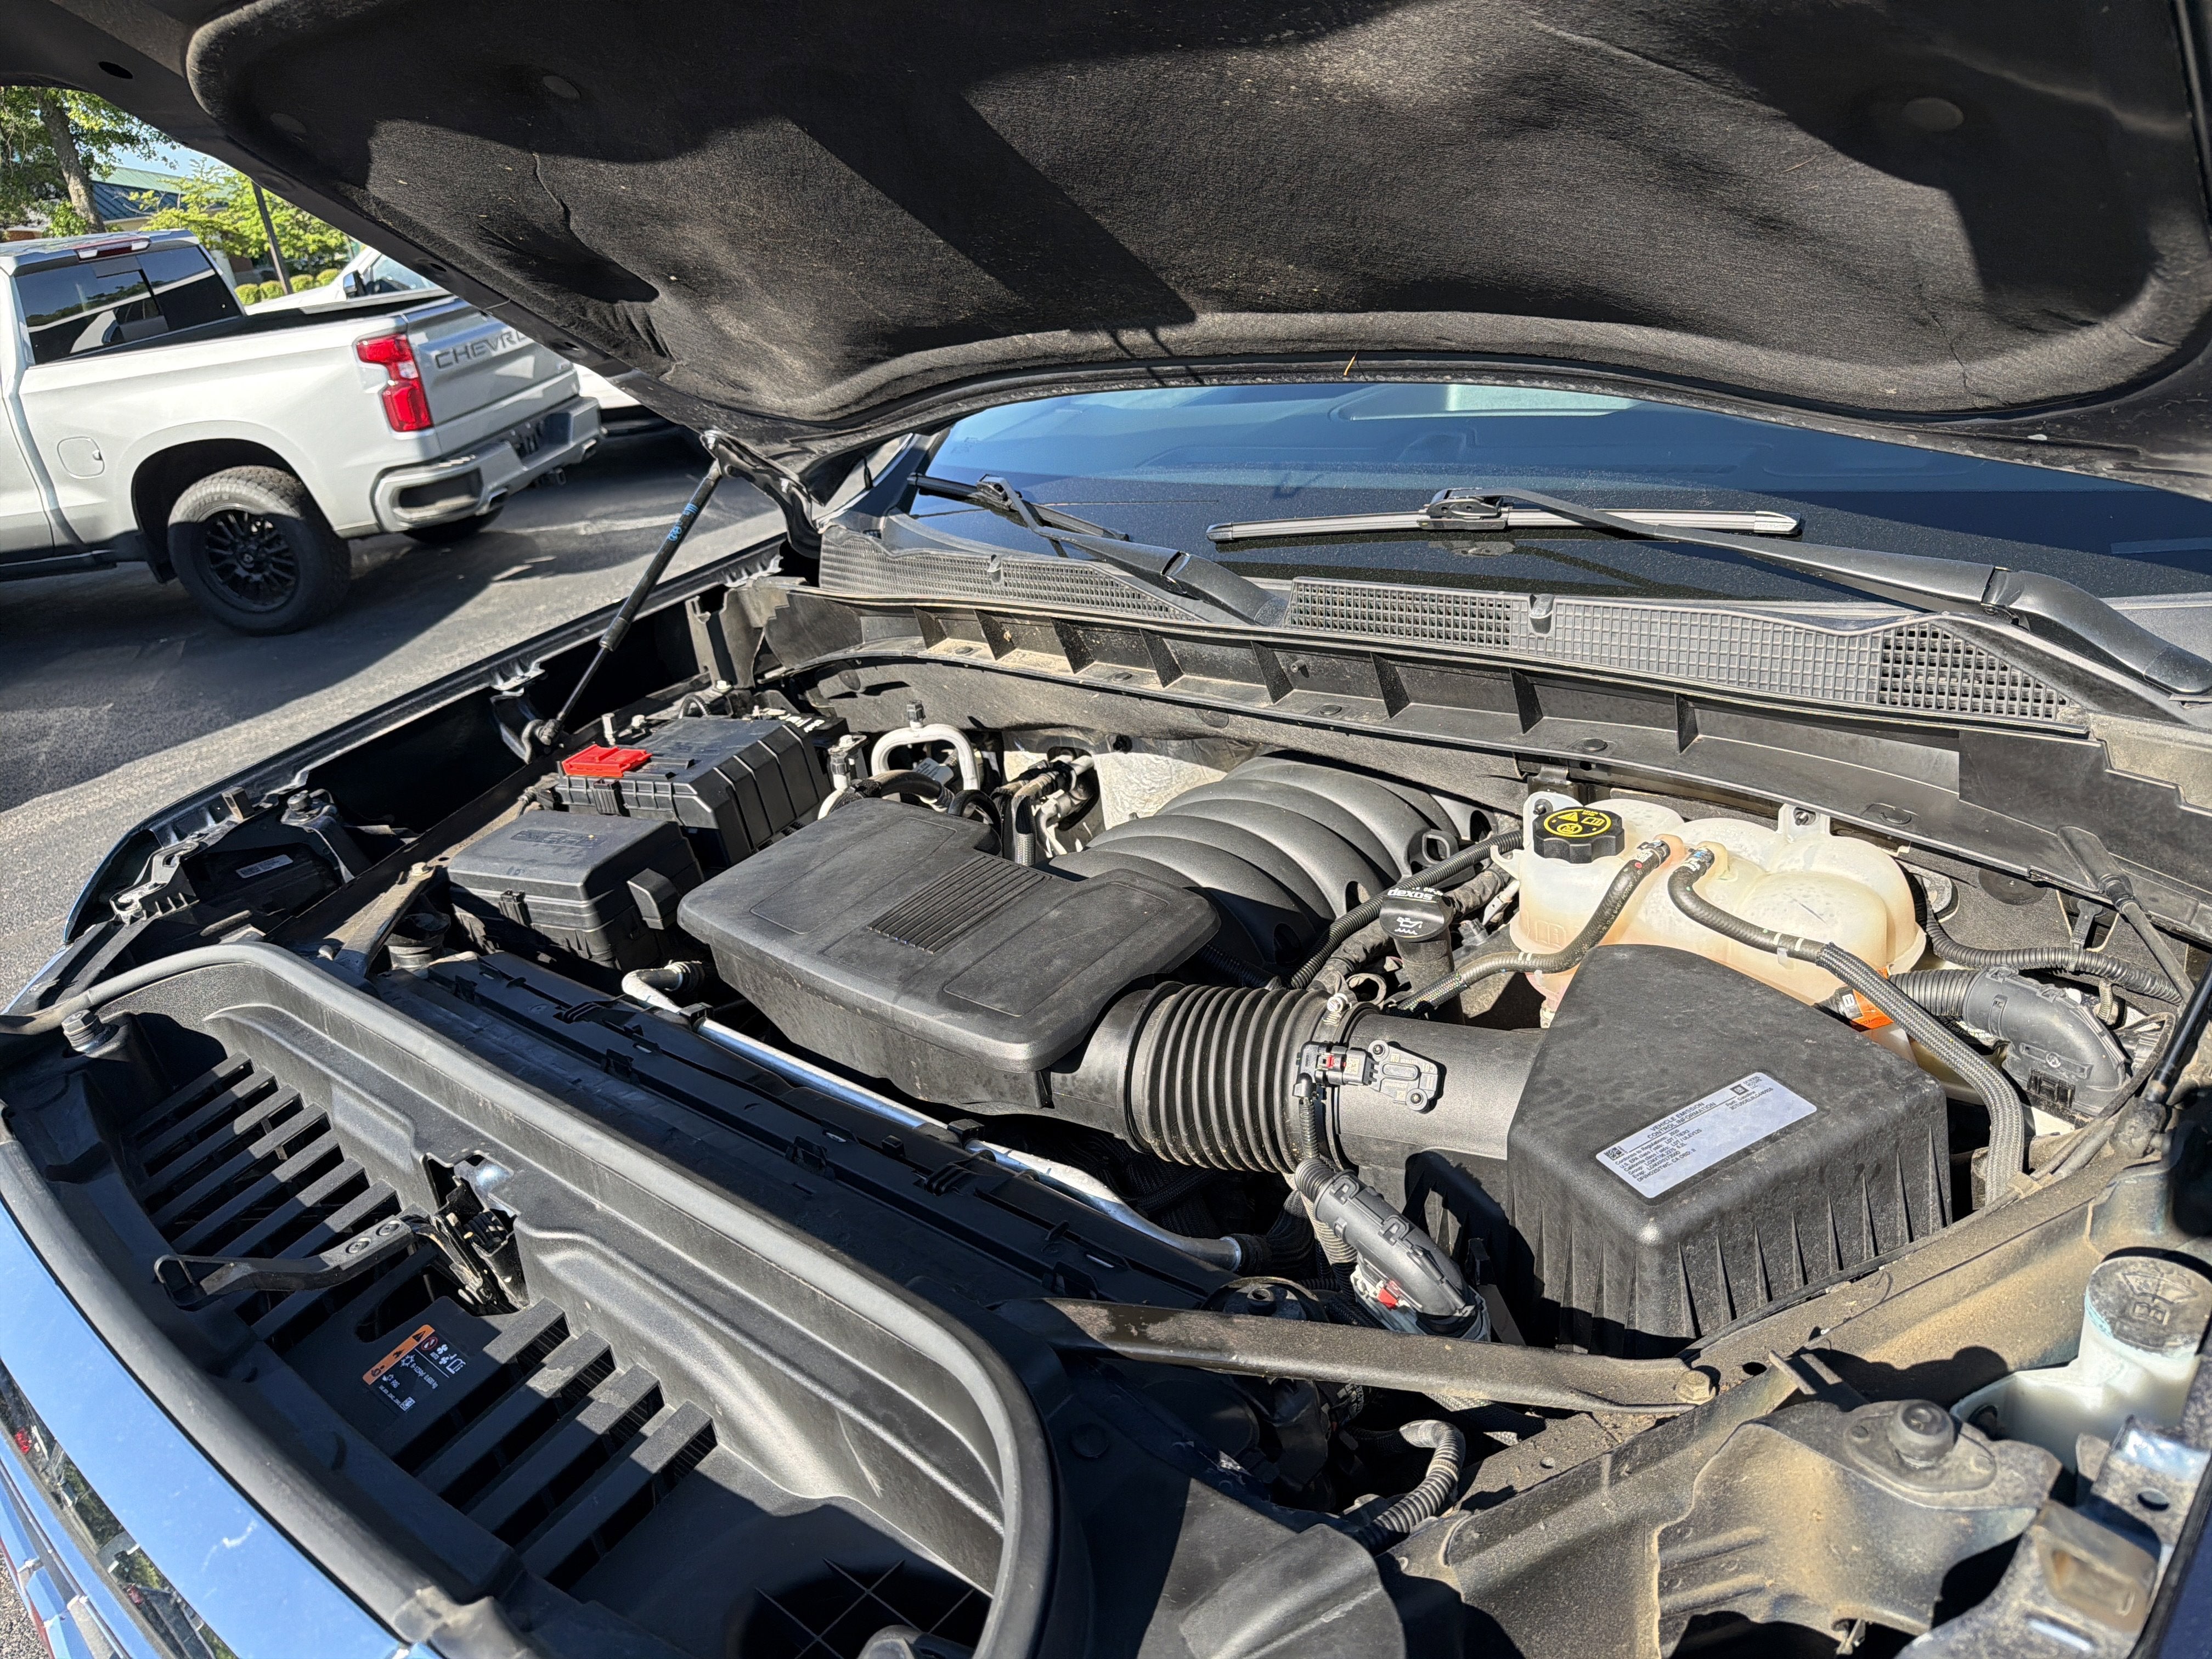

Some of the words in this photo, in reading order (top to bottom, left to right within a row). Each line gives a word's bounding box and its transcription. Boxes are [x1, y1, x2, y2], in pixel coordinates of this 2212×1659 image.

[1387, 888, 1435, 900] dexos
[1946, 1023, 1960, 1033] FLUID
[1647, 1123, 1677, 1139] CONTROL
[1675, 1102, 1717, 1124] INFORMATION
[1650, 1116, 1677, 1131] VEHICLE
[1675, 1102, 1705, 1119] EMISSION
[1615, 1153, 1638, 1165] Conforms
[1640, 1136, 1670, 1152] Regulations:
[1639, 1150, 1651, 1159] class
[1623, 1159, 1646, 1172] California
[1644, 1153, 1657, 1161] class
[1628, 1165, 1645, 1176] Group:
[1632, 1170, 1646, 1179] Evap:
